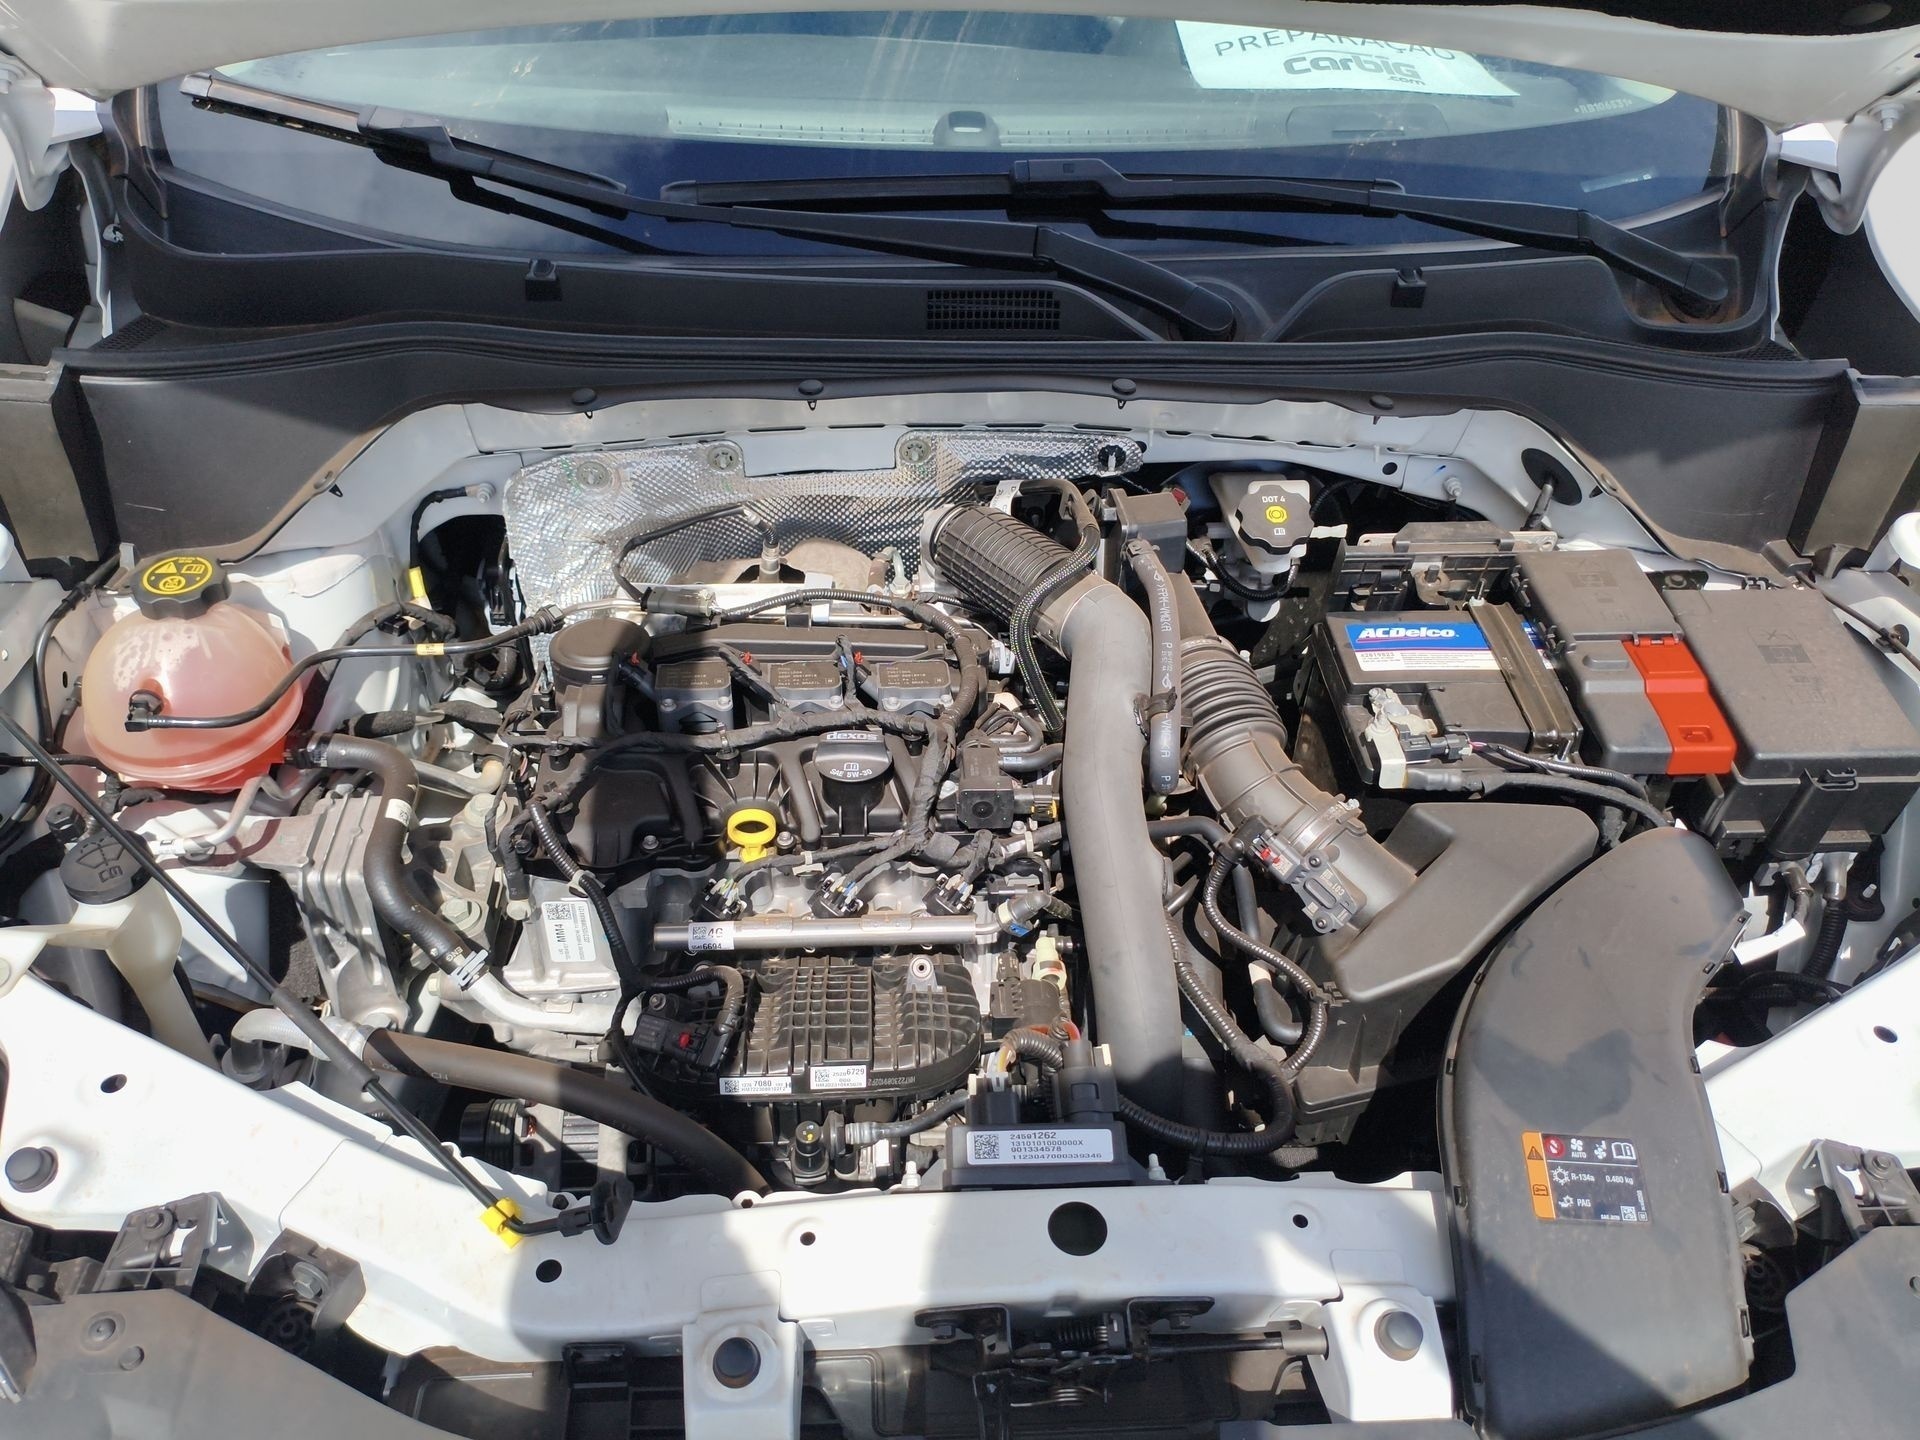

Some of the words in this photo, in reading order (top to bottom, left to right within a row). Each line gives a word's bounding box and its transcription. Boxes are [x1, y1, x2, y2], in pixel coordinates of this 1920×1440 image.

[1261, 495, 1278, 503] DOT
[1280, 495, 1286, 503] 4
[1358, 627, 1456, 639] ACDelco
[826, 731, 878, 741] dexos
[830, 768, 845, 778] SAE
[846, 768, 873, 778] 5W-30
[554, 923, 567, 943] MM4
[1571, 1173, 1595, 1182] R-134a
[1625, 1177, 1633, 1185] kg
[1577, 1199, 1591, 1207] PAG
